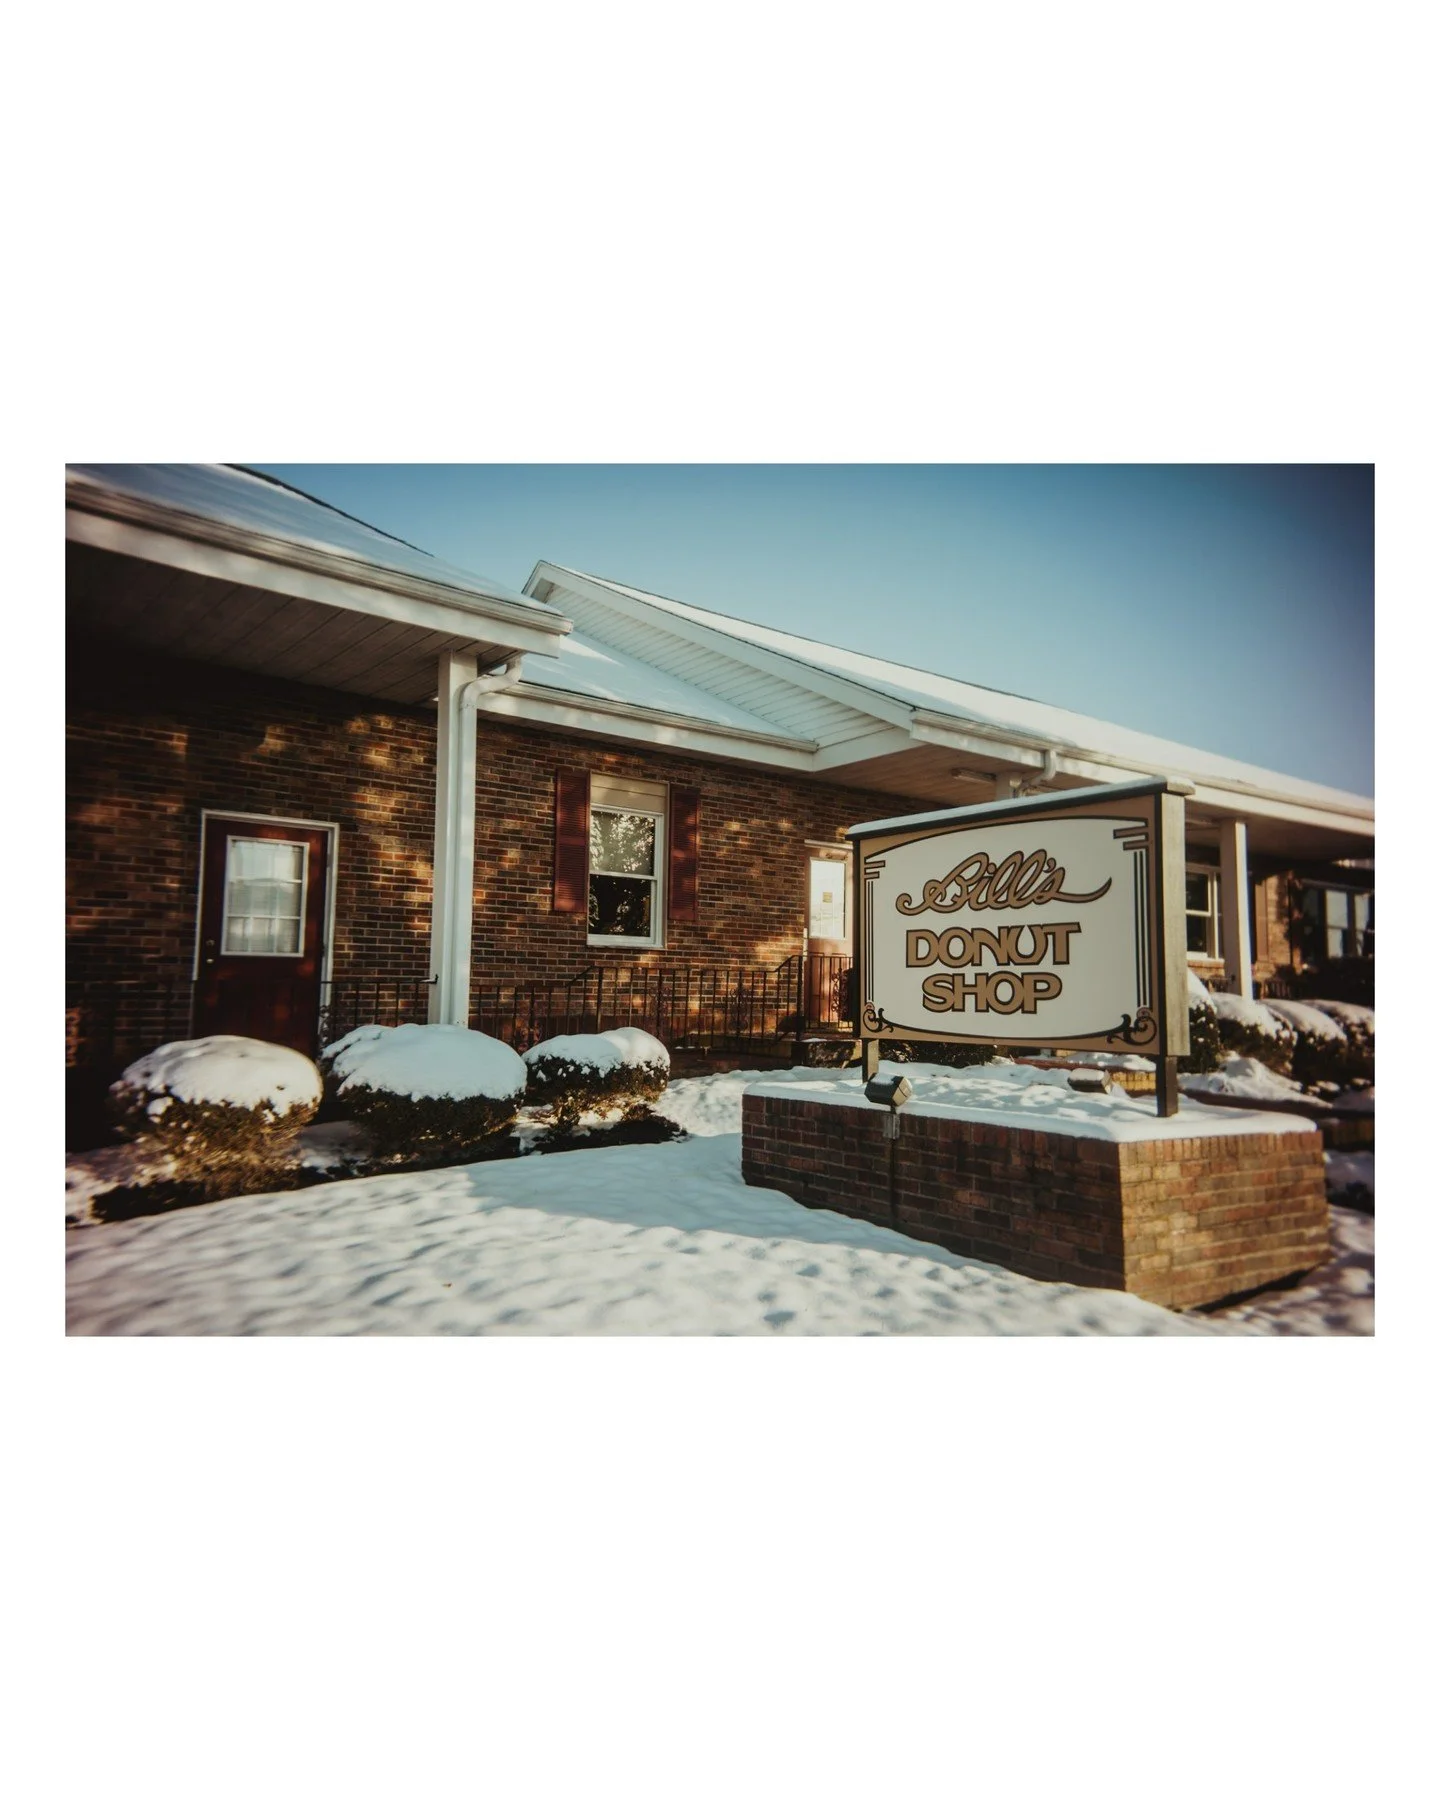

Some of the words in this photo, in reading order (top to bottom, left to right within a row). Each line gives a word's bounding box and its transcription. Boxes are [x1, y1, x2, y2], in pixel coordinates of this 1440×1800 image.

[896, 849, 1112, 916] Bill's
[906, 922, 1082, 968] DONUT
[922, 971, 1062, 1015] SHOP
